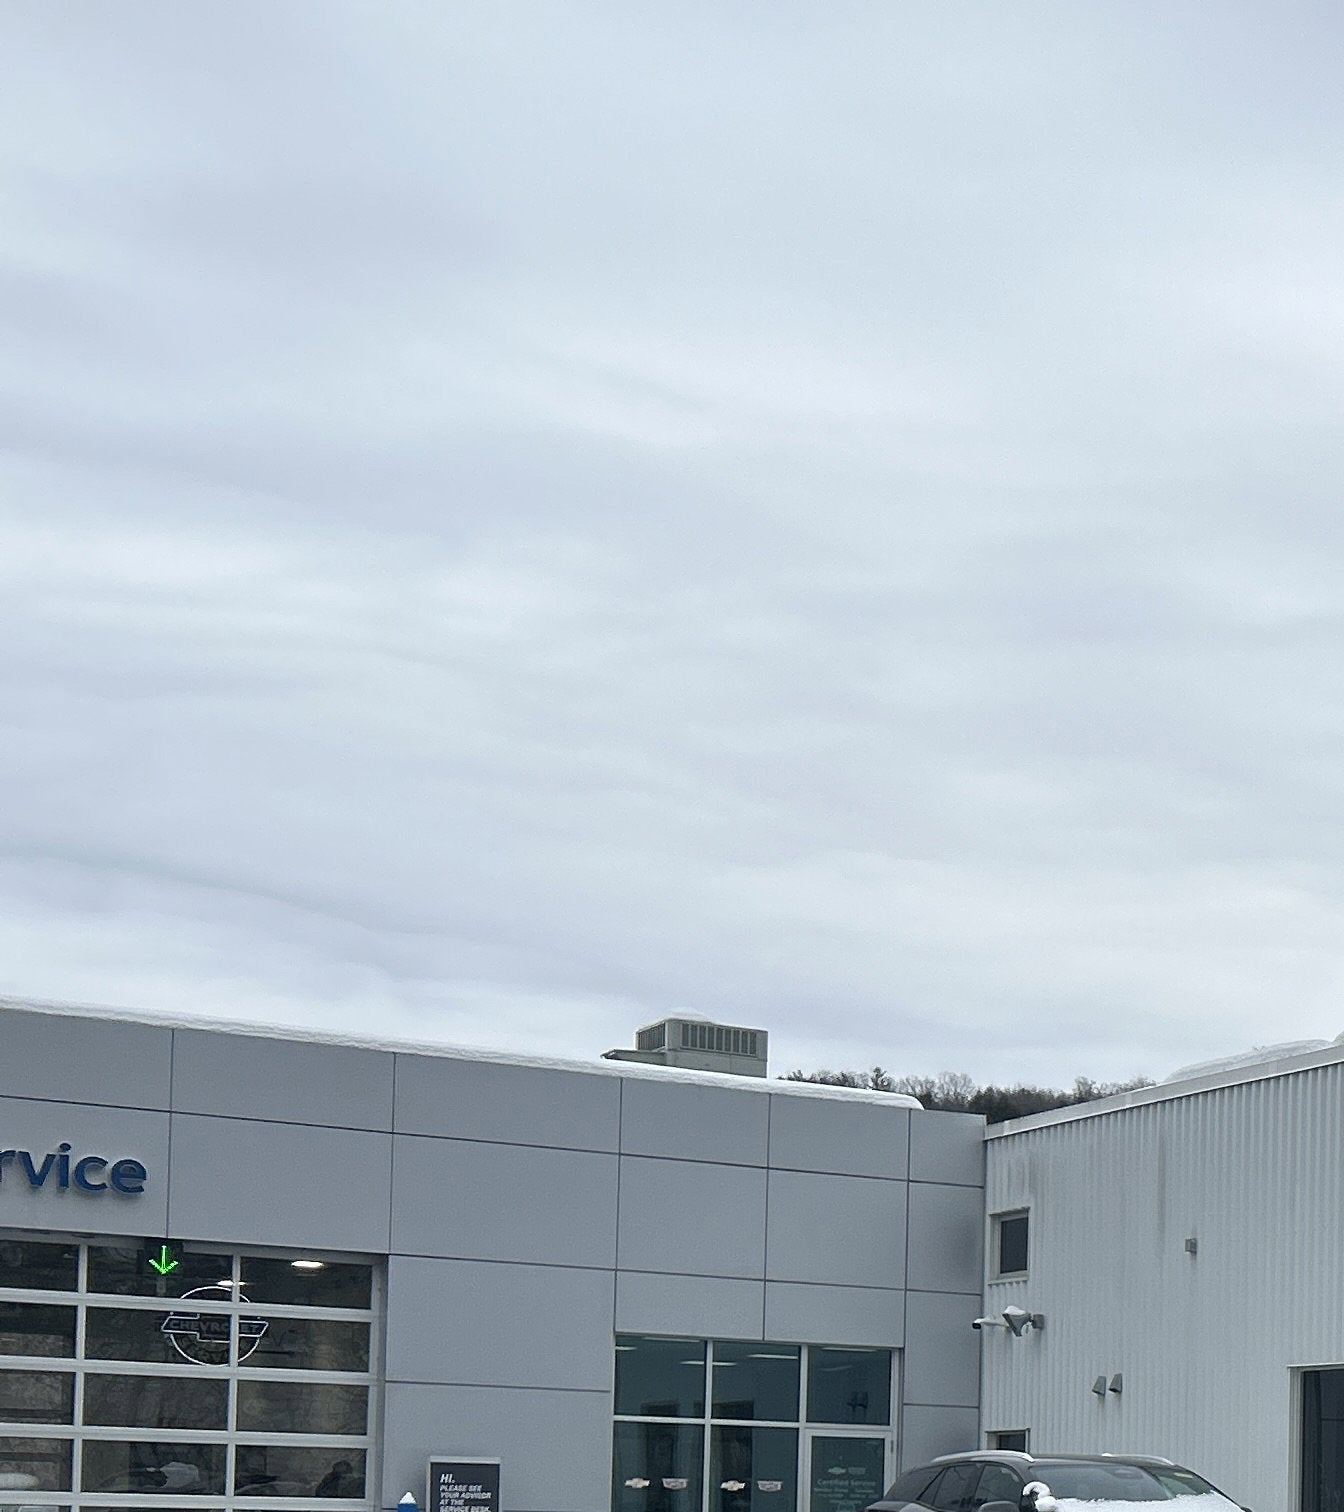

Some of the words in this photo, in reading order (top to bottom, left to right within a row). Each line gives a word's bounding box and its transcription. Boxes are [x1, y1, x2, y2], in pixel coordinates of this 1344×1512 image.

[0, 1142, 148, 1194] rvice
[168, 1320, 261, 1334] CHEVROET
[440, 1473, 456, 1484] HI.
[440, 1484, 467, 1492] PLEASE
[469, 1484, 483, 1492] SEE
